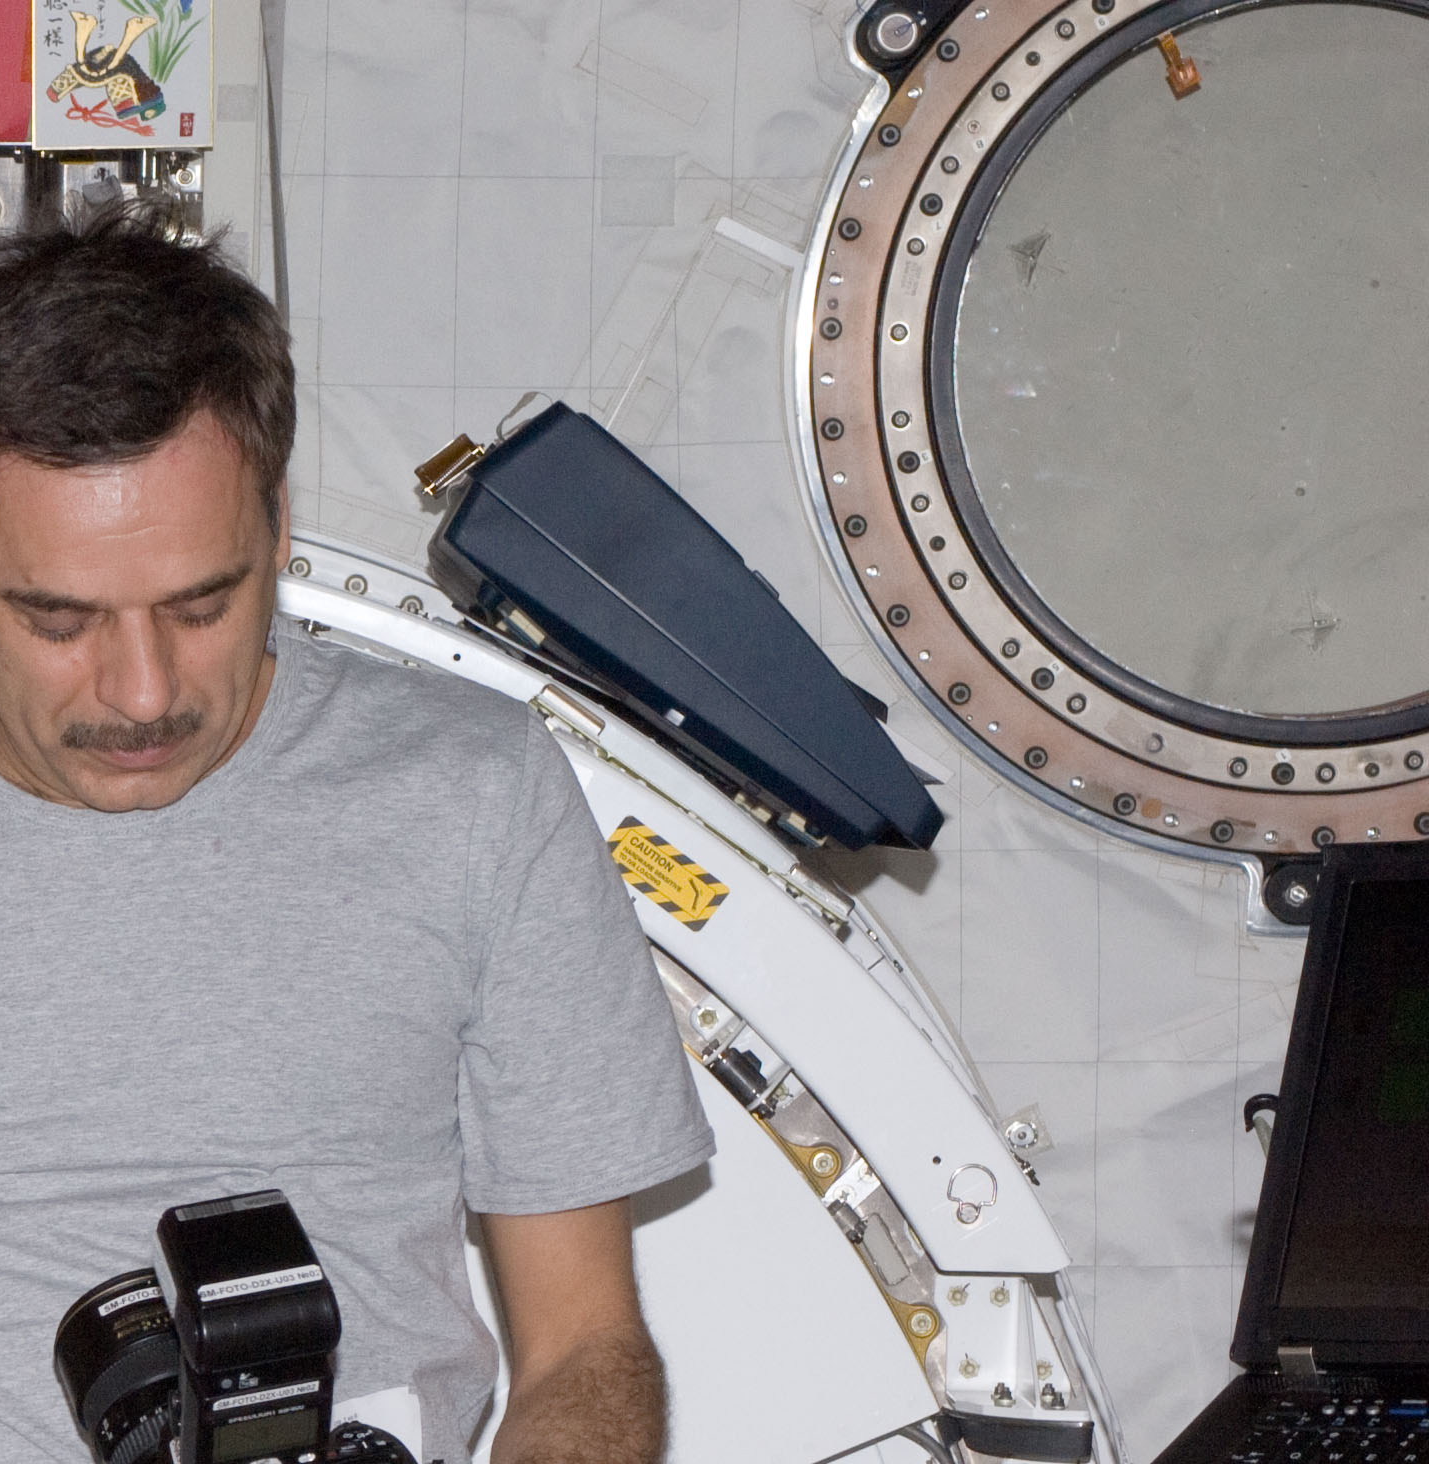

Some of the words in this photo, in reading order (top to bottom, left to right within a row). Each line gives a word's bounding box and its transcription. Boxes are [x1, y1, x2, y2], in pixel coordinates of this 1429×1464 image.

[629, 836, 675, 873] CAUTION
[1329, 1453, 1344, 1461] W
[1365, 1453, 1378, 1461] E
